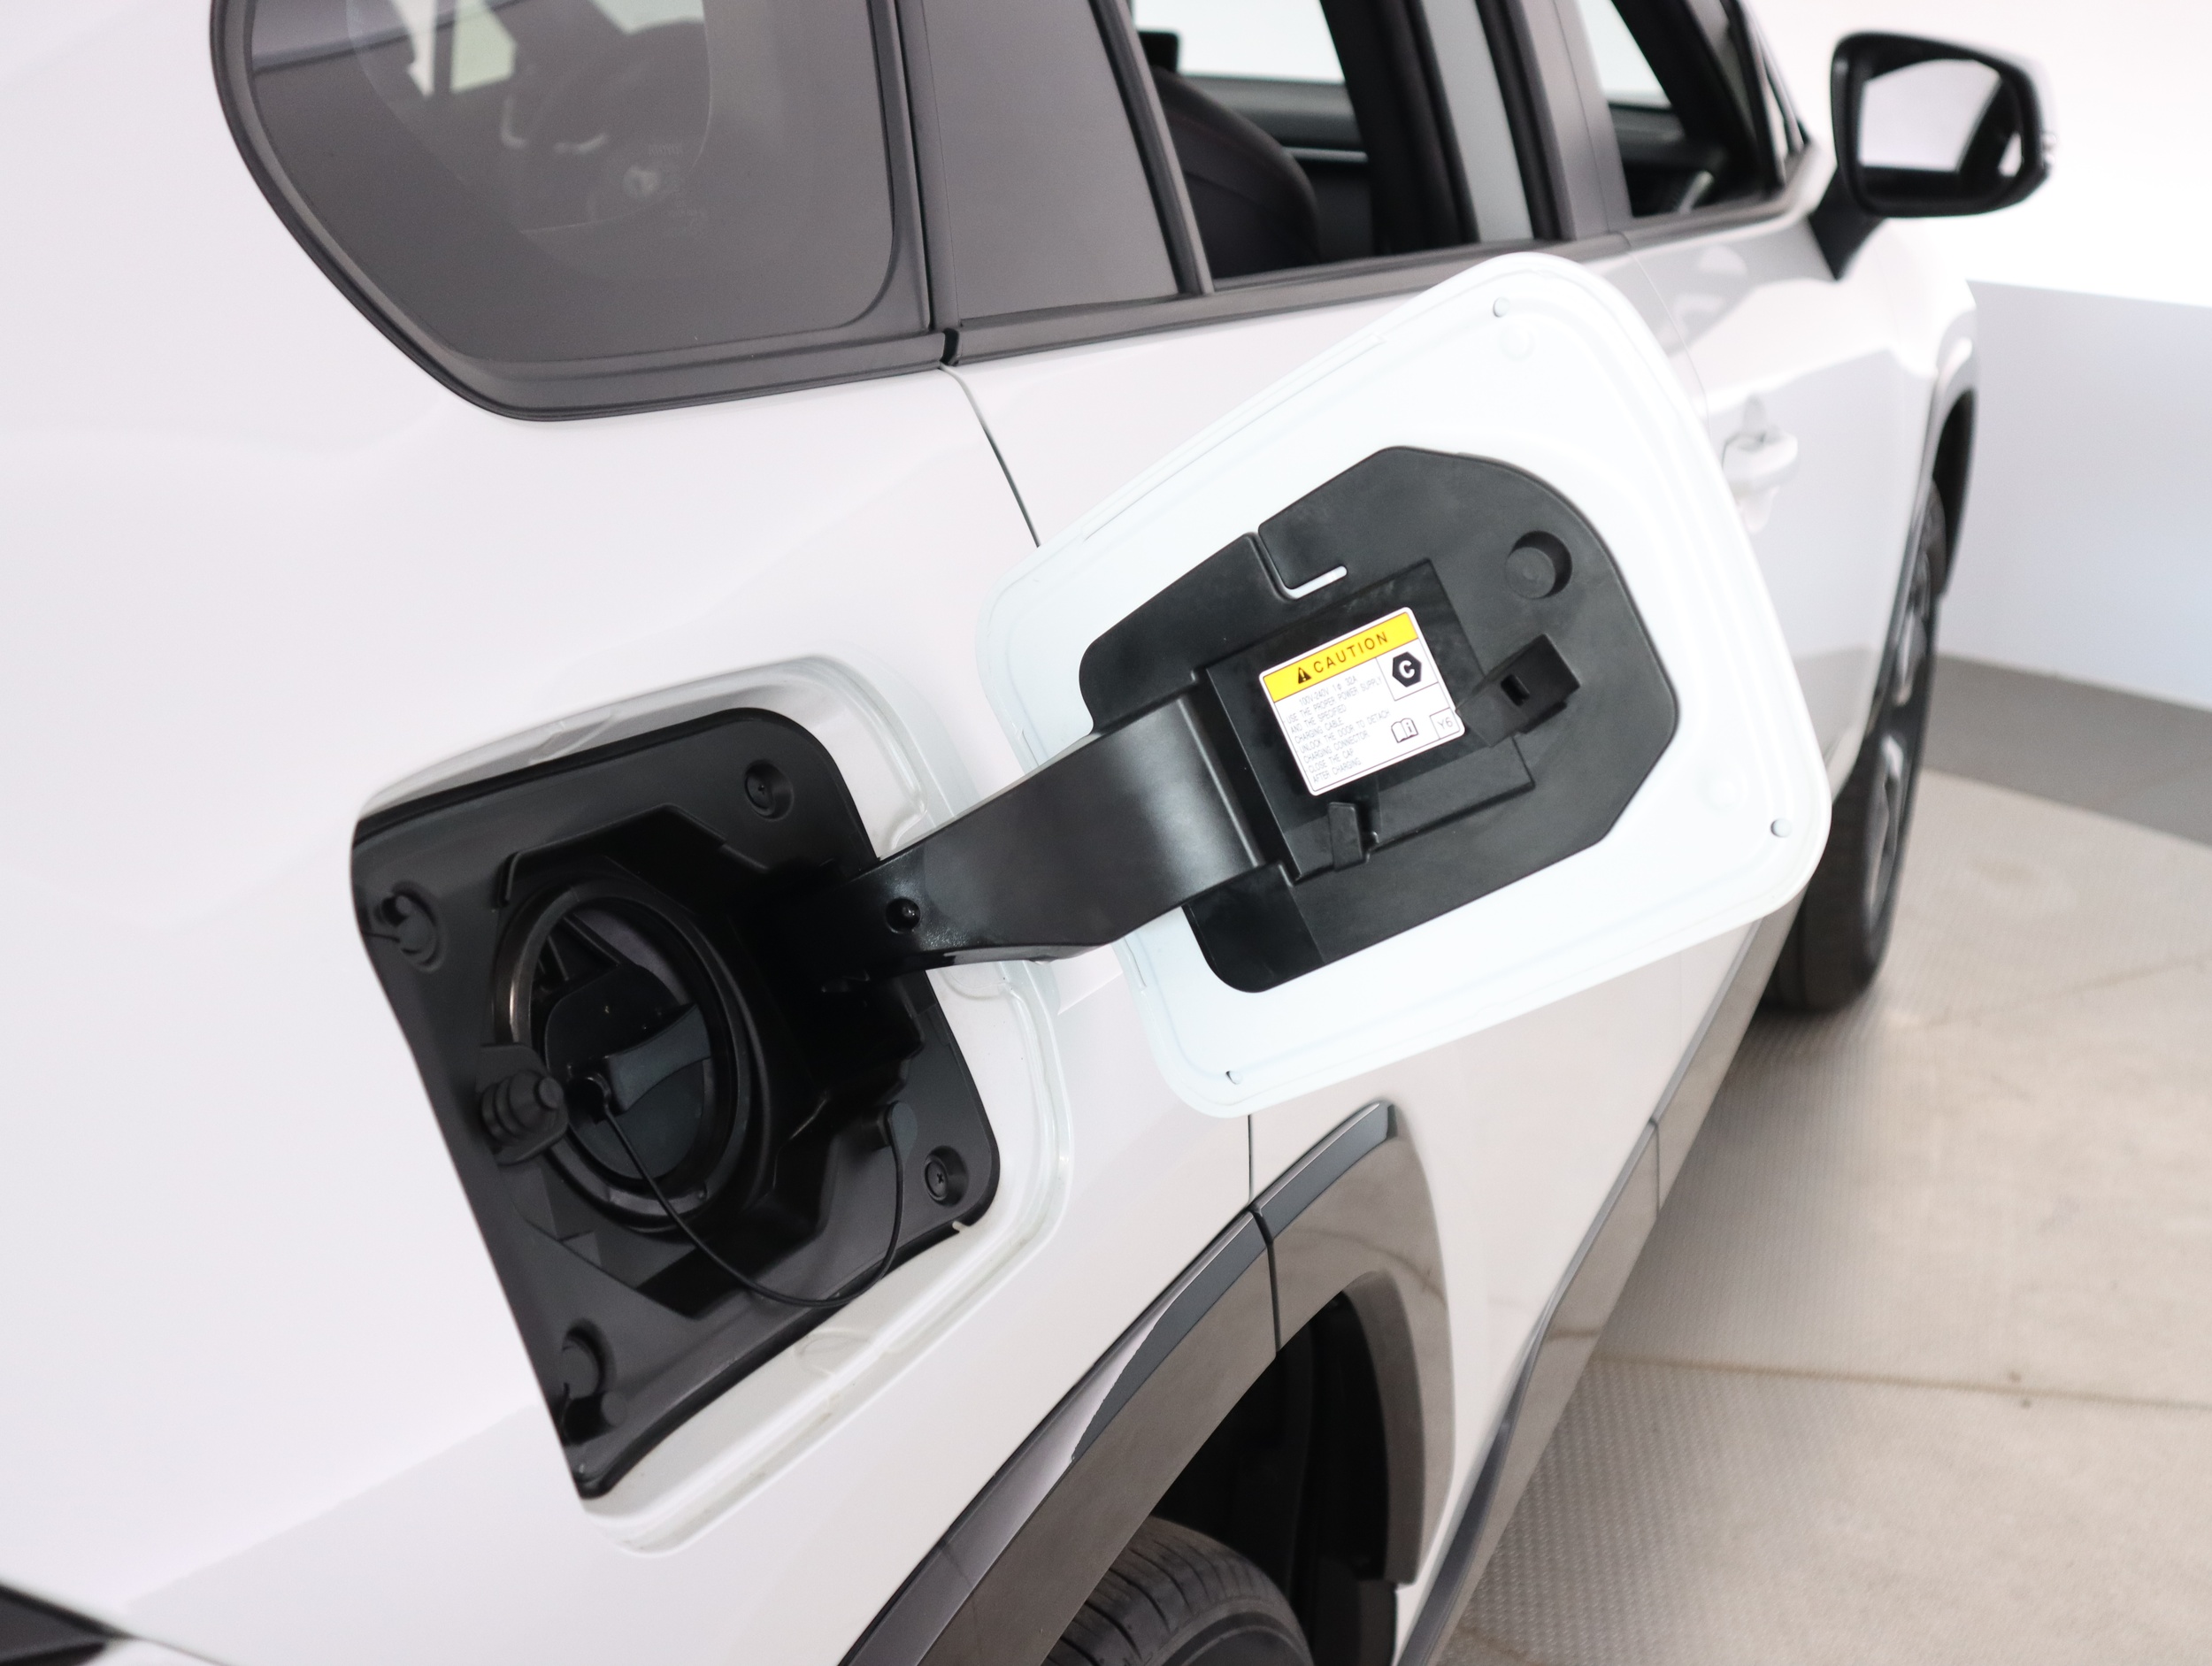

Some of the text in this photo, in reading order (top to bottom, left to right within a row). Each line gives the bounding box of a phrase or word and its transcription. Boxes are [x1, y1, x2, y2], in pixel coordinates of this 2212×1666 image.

[1313, 632, 1387, 673] CAUTION
[1398, 659, 1415, 679] C
[1344, 674, 1357, 687] 32A
[1286, 676, 1382, 725] USE THE PROPER POWER SUPPLY
[1289, 702, 1347, 734] AND THE SPECIFIED
[1436, 716, 1454, 730] Y6
[1294, 725, 1324, 744] CHARGING
[1299, 709, 1390, 754] UNLOCK THE DOOR TO DETACH
[1302, 745, 1333, 764] CHARGING
[1307, 758, 1327, 773] CLOSE
[1327, 753, 1341, 764] THE
[1311, 769, 1330, 783] AFTER
